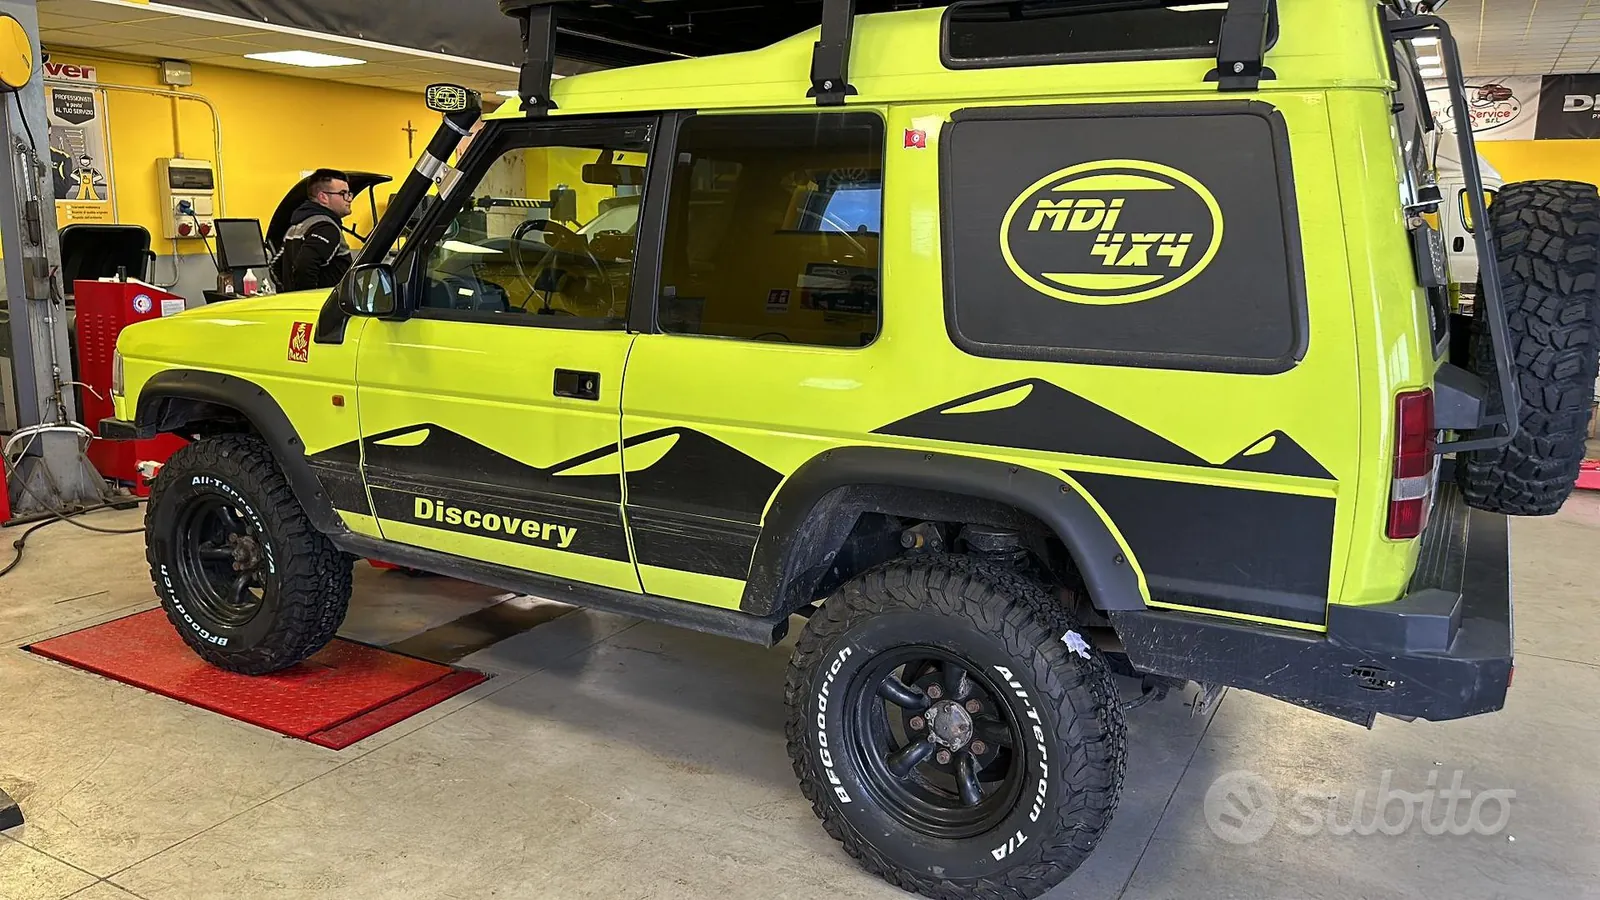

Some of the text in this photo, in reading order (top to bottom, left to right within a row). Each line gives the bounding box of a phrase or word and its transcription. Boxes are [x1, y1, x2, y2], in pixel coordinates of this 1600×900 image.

[42, 62, 94, 79] ver
[192, 476, 263, 532] All-Terrain
[414, 496, 578, 548] Discovery
[160, 564, 228, 646] BFGoodrich
[817, 646, 852, 803] BFGoodrich
[990, 665, 1048, 861] All-Terrain T/A
